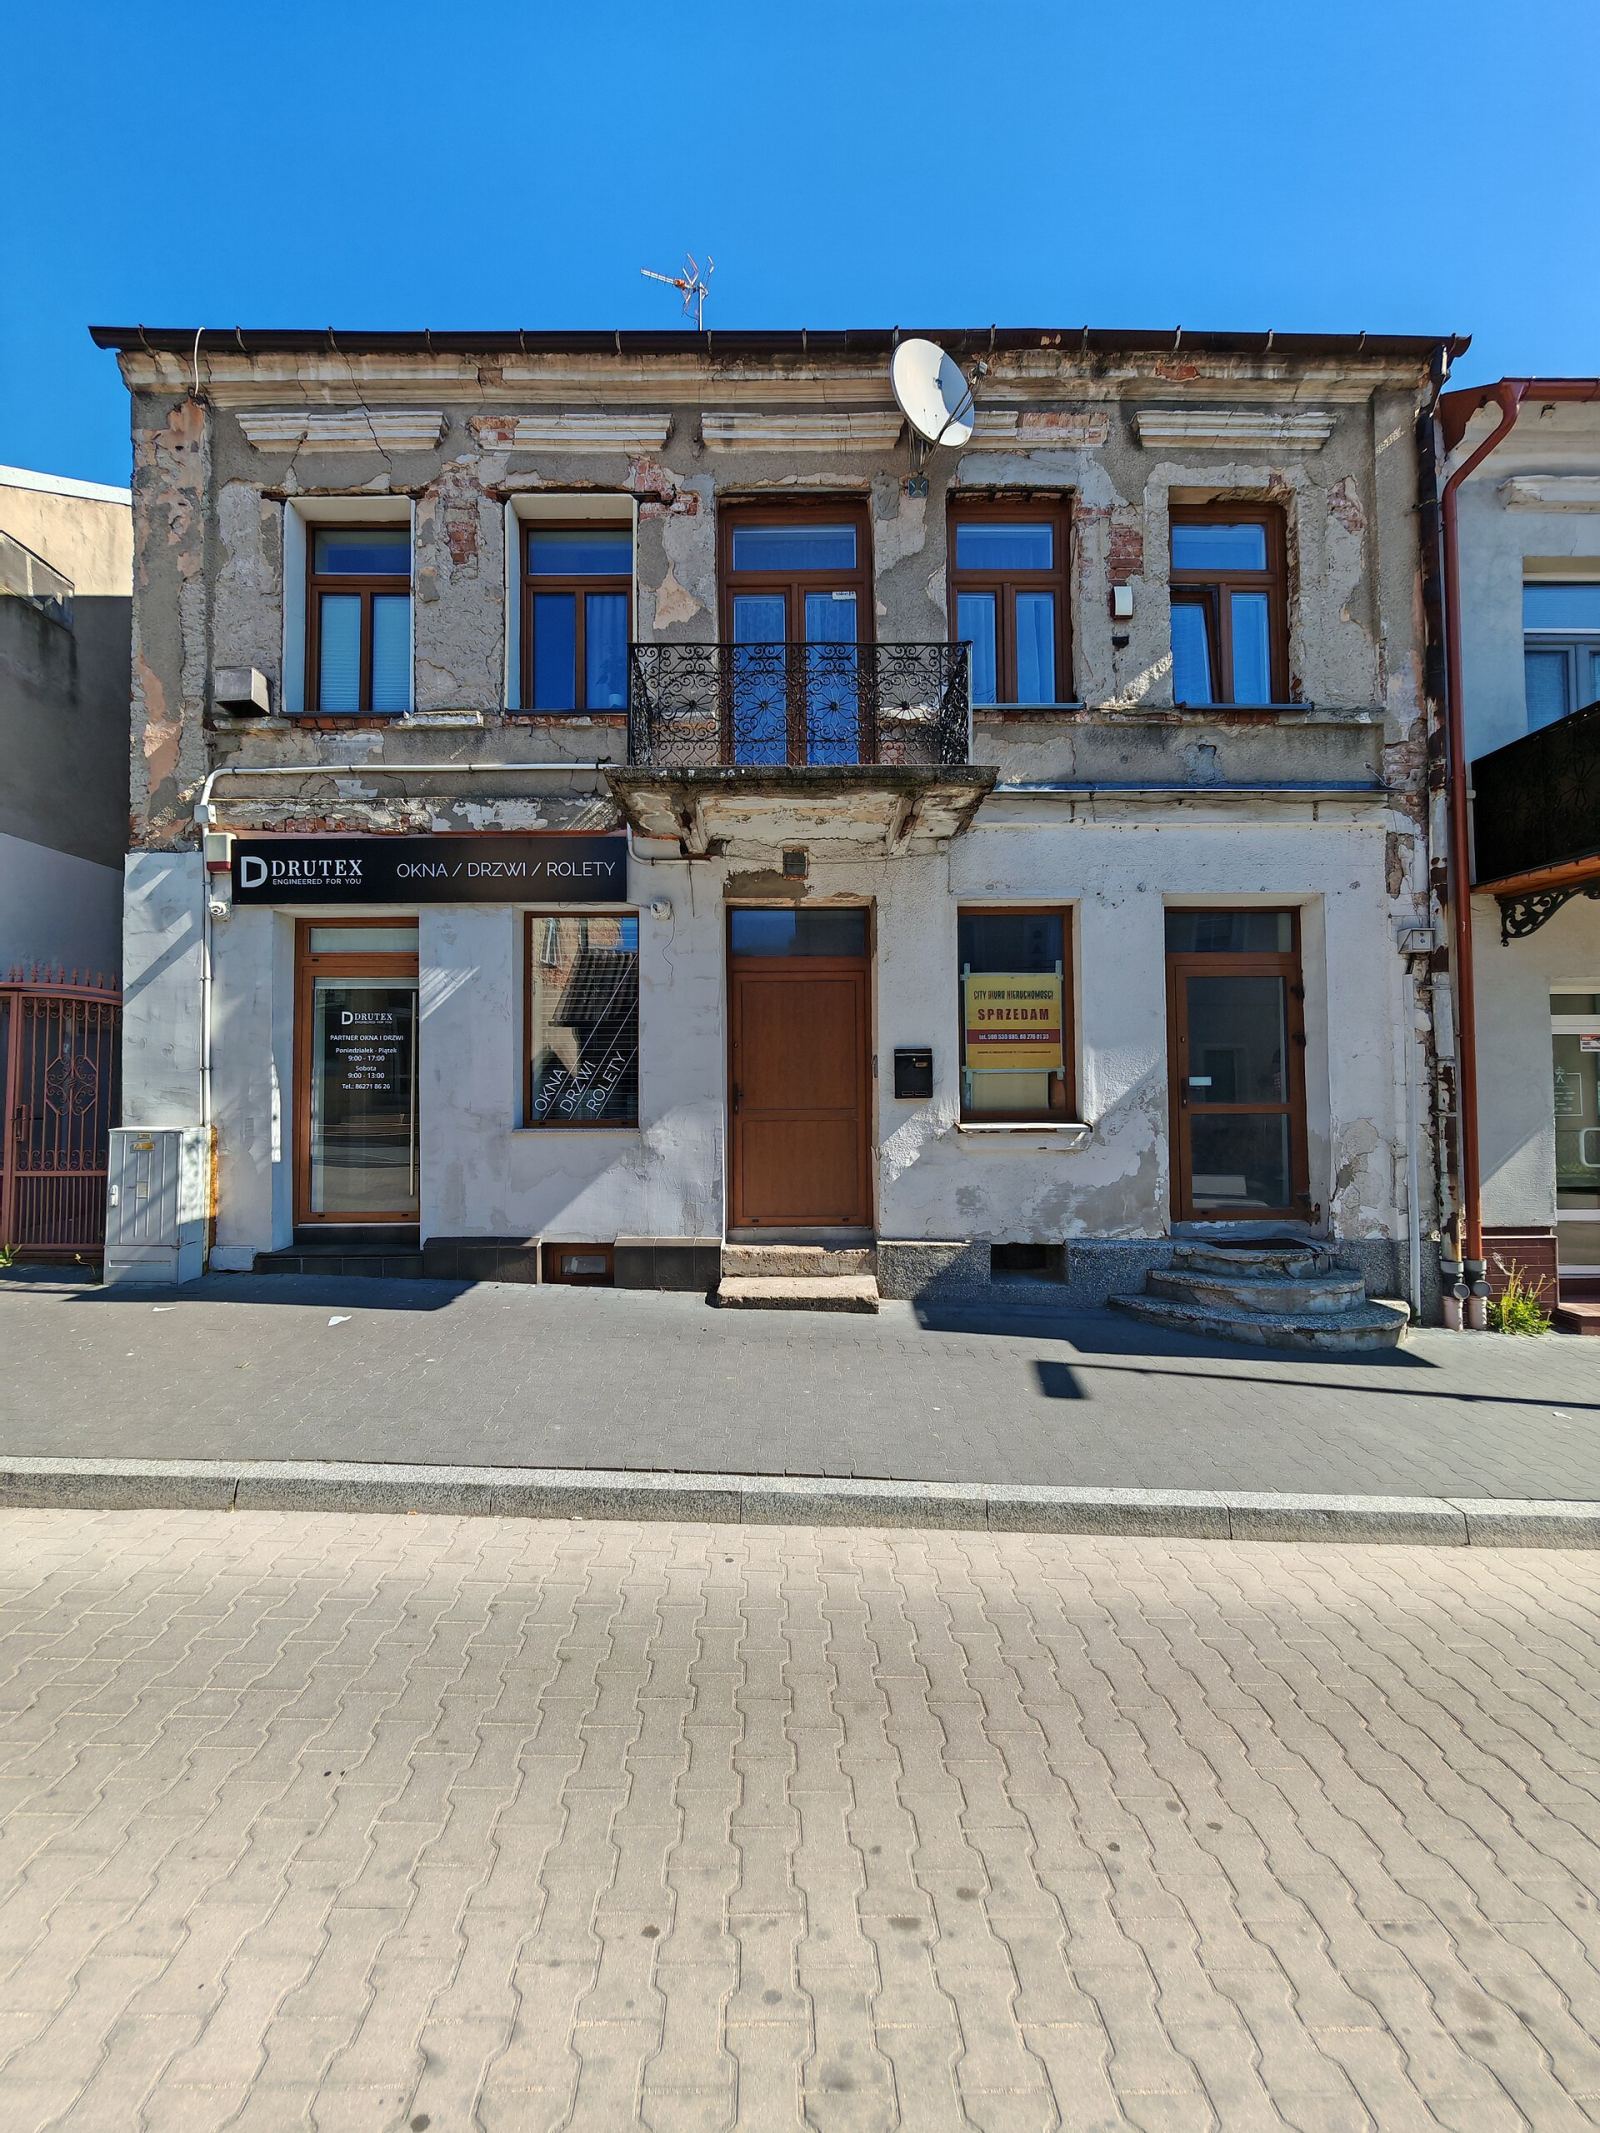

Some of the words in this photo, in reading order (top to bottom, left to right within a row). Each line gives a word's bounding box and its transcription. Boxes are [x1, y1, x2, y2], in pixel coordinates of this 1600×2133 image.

[271, 859, 363, 877] DRUTEX
[396, 863, 448, 878] OKNA
[467, 862, 526, 877] DRZWI
[547, 861, 616, 876] ROLETY
[272, 878, 323, 886] ENGINEERED
[973, 990, 987, 1000] CITY
[354, 1012, 393, 1021] DRUTEX
[977, 1008, 1049, 1020] SPRZEDAM
[559, 1060, 597, 1113] DRZWI
[586, 1051, 626, 1112] ROLETY
[534, 1069, 567, 1112] OKNA
